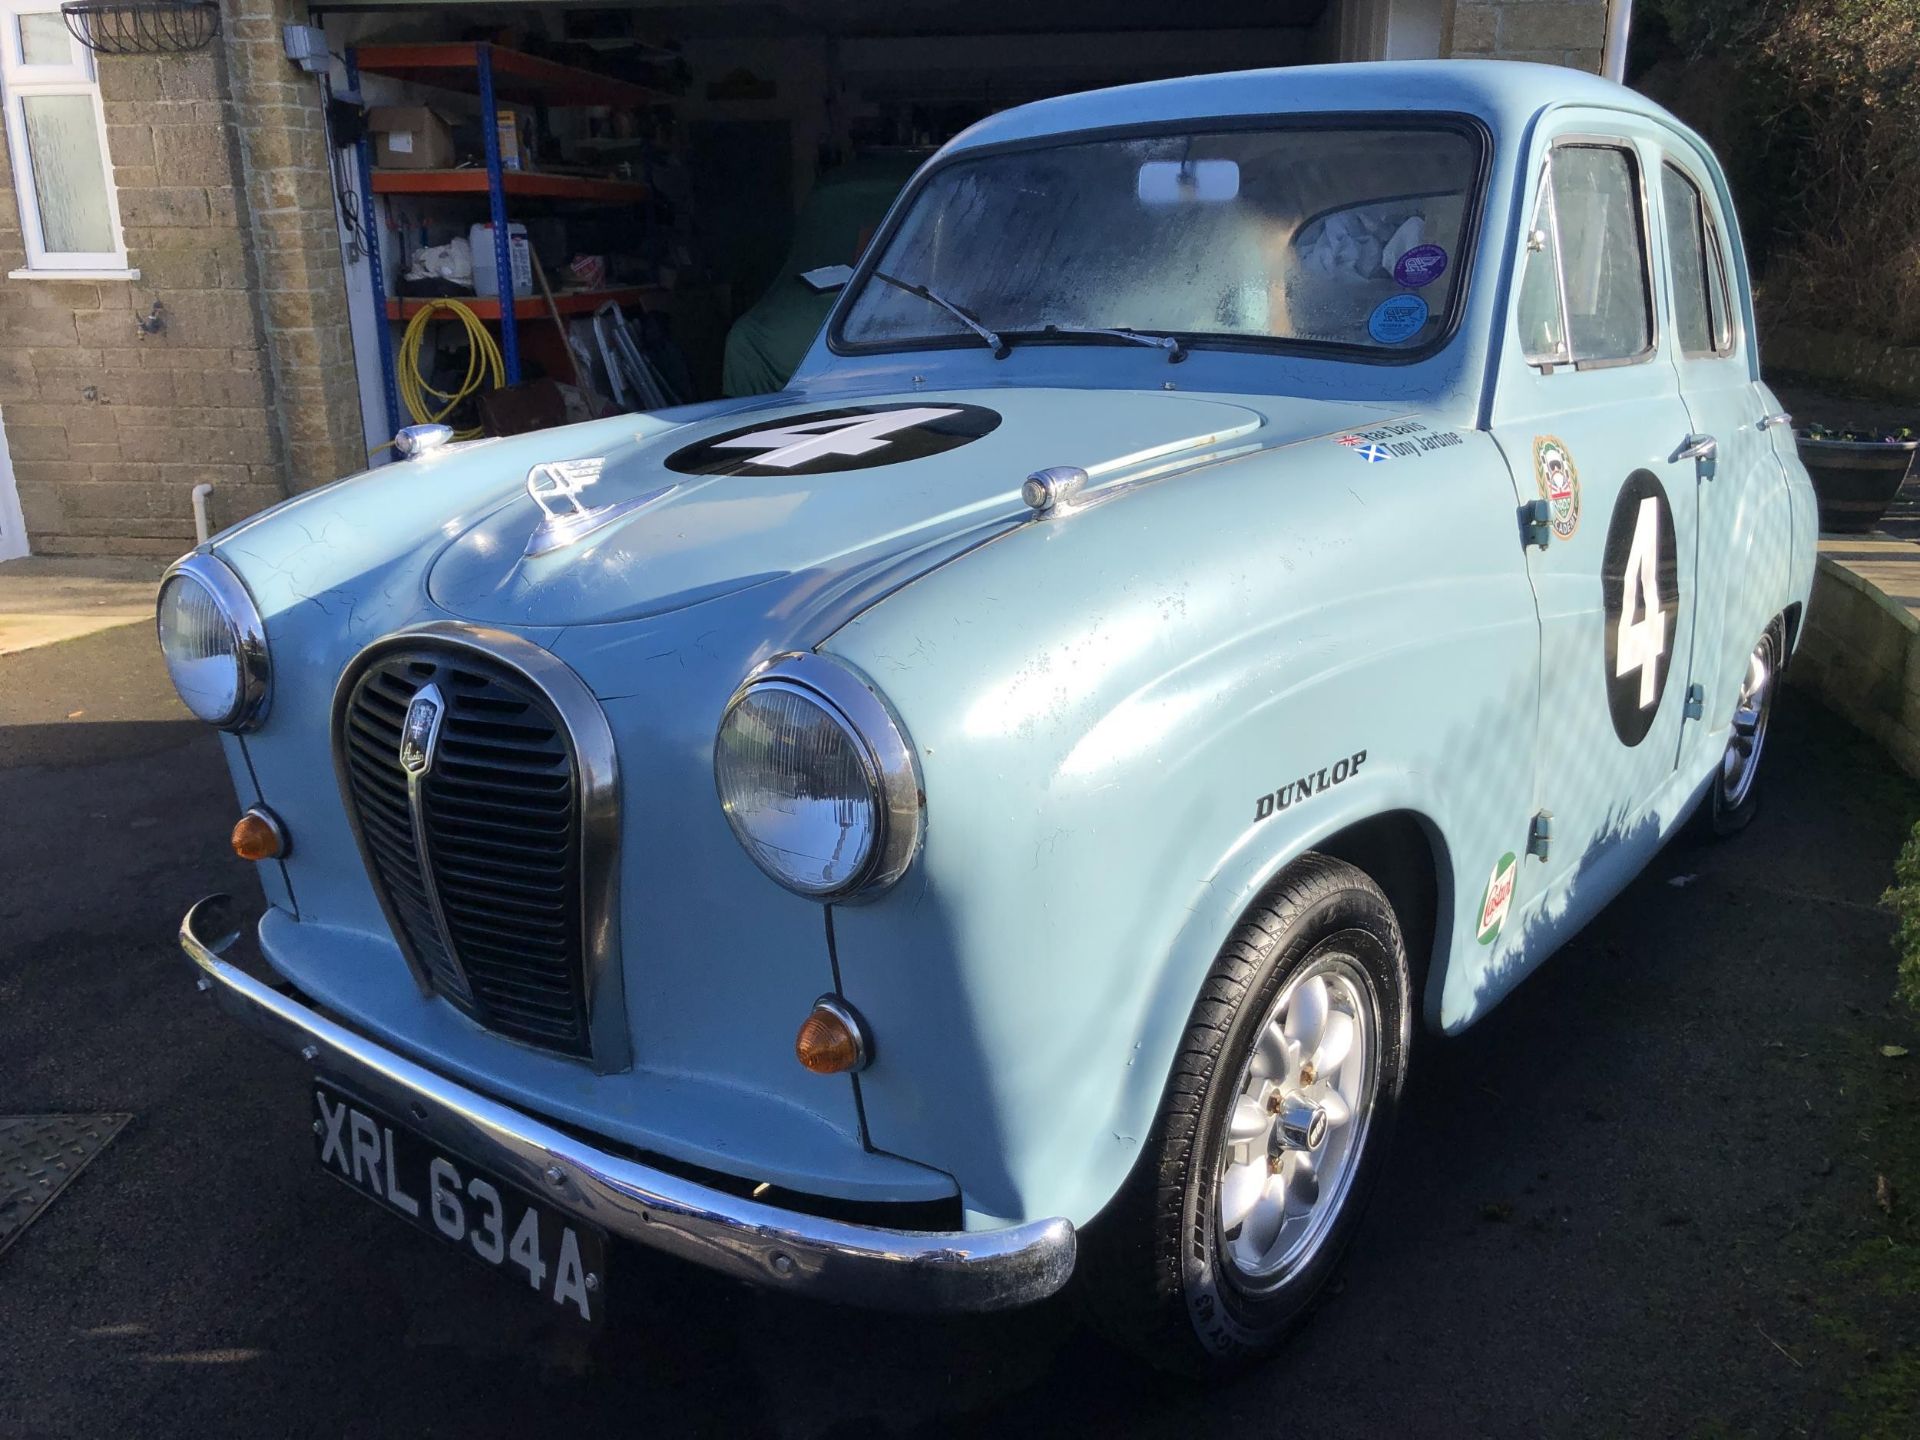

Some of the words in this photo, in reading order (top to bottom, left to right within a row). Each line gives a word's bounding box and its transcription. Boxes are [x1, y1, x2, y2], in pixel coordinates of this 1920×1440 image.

[709, 407, 964, 468] 4
[1378, 442, 1422, 457] Tony
[1412, 430, 1464, 452] Jardine
[1381, 422, 1428, 436] Davis
[1615, 496, 1666, 709] 4
[1253, 748, 1367, 823] DUNLOP
[317, 1091, 419, 1217] XRL
[429, 1156, 591, 1322] 634A
